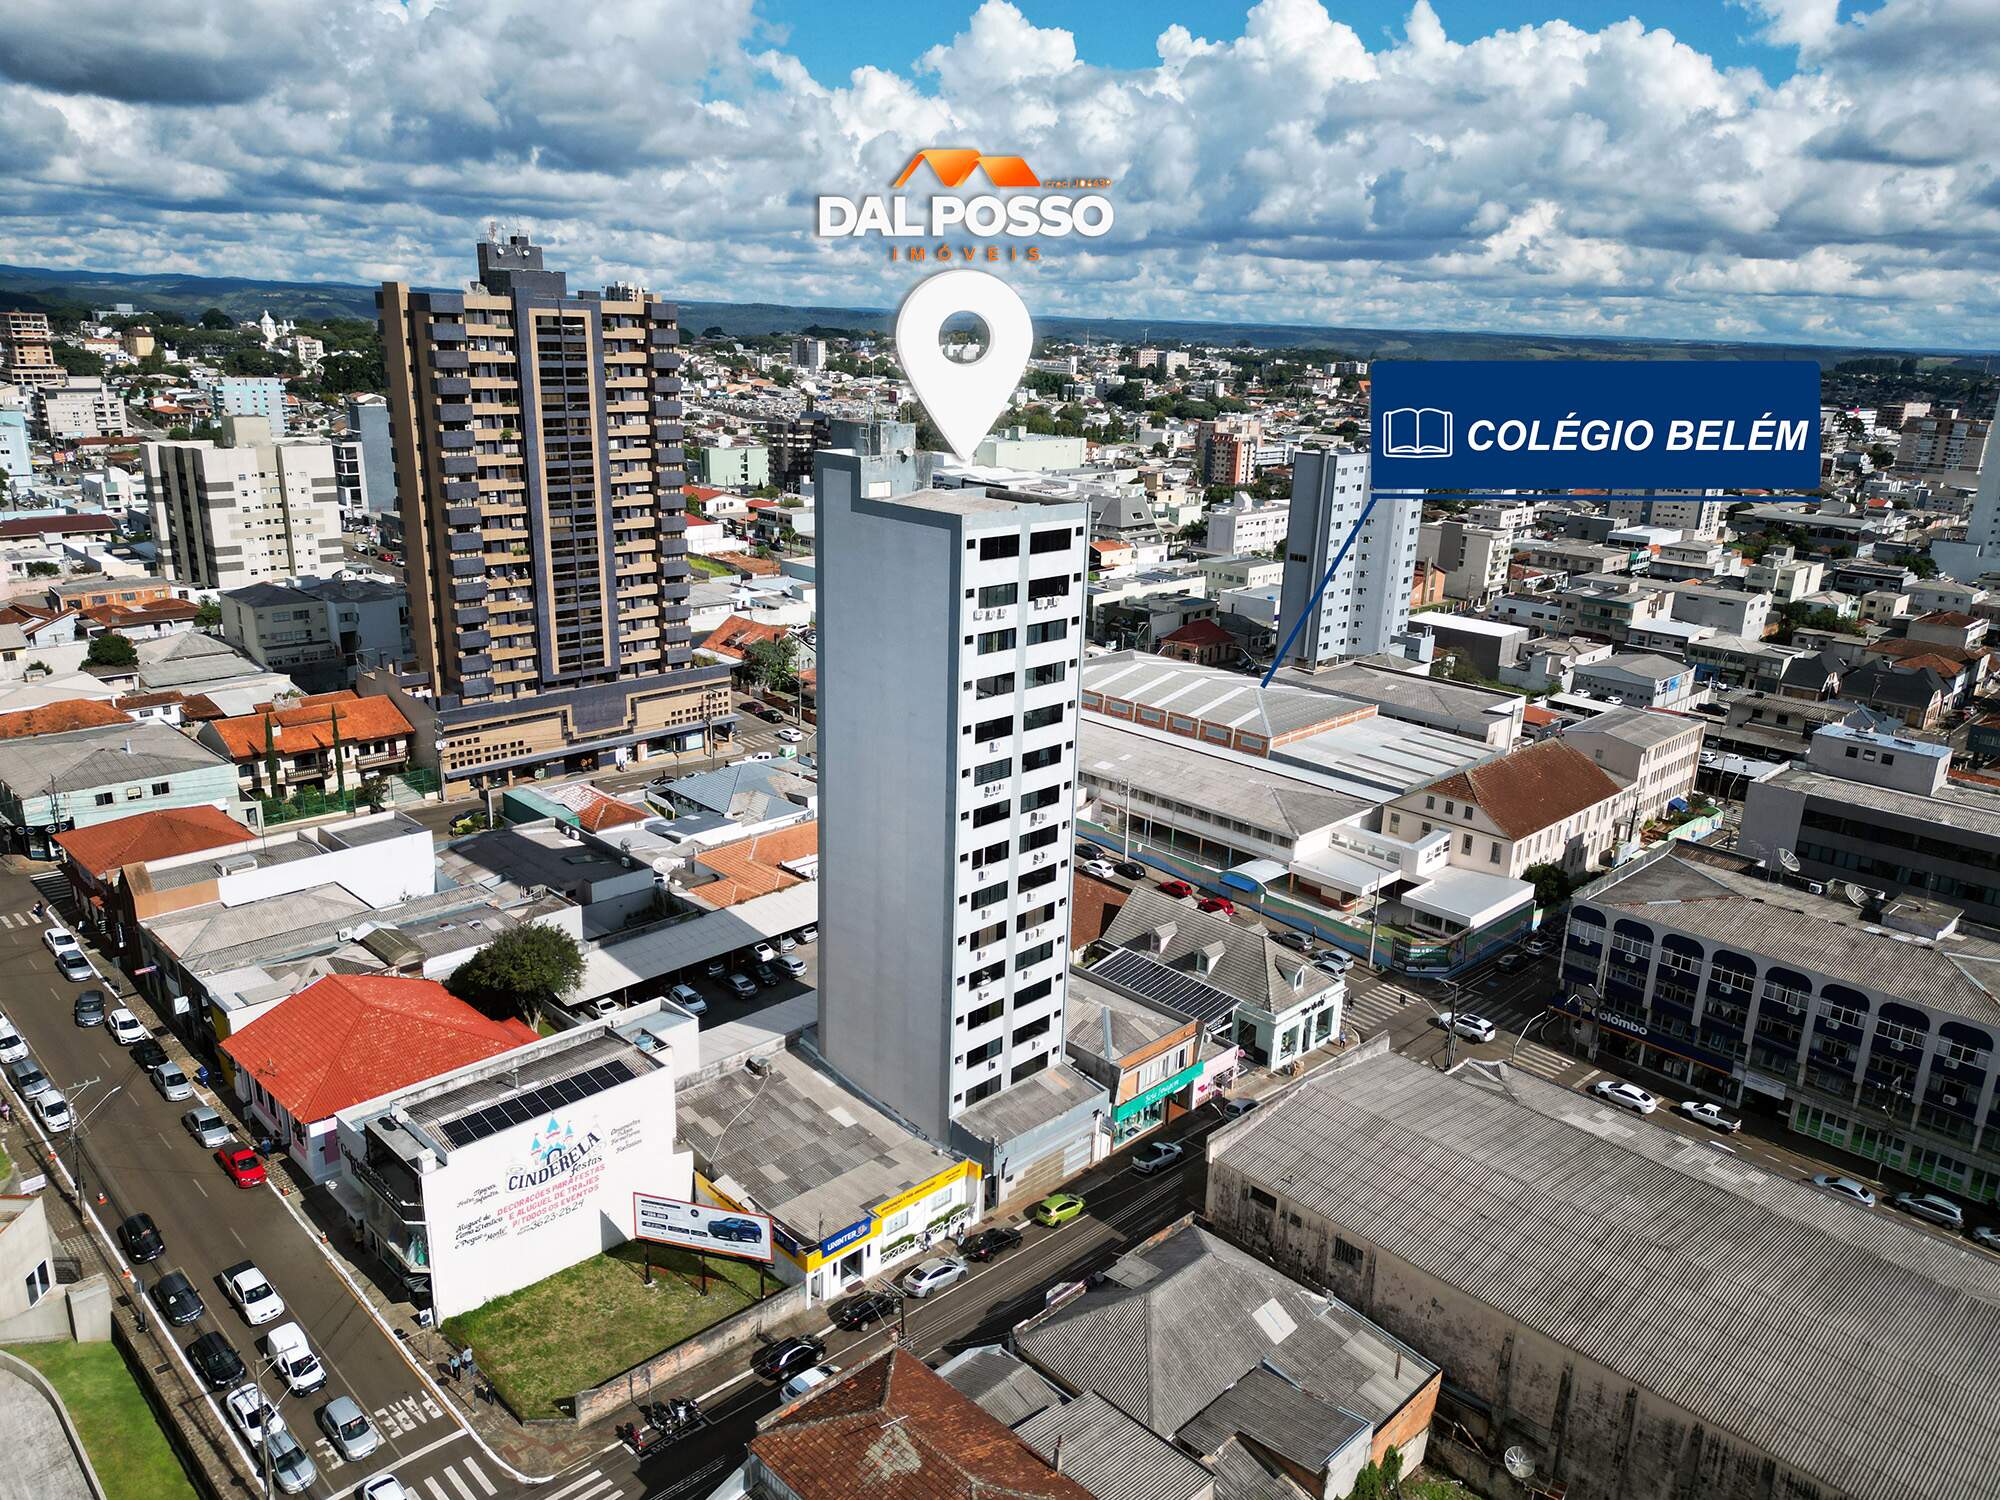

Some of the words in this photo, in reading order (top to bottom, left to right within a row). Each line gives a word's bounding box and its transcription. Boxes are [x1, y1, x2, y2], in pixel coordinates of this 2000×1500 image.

[508, 1132, 601, 1191] CINDERELA
[552, 1176, 574, 1192] PARA
[574, 1163, 606, 1182] FESTAS
[569, 1155, 603, 1177] festas
[509, 1211, 515, 1221] E
[516, 1197, 552, 1216] ALUGUEL
[554, 1190, 566, 1201] DE
[567, 1174, 600, 1193] TRAJES
[560, 1183, 600, 1206] EVENTOS
[374, 1390, 444, 1439] PARE
